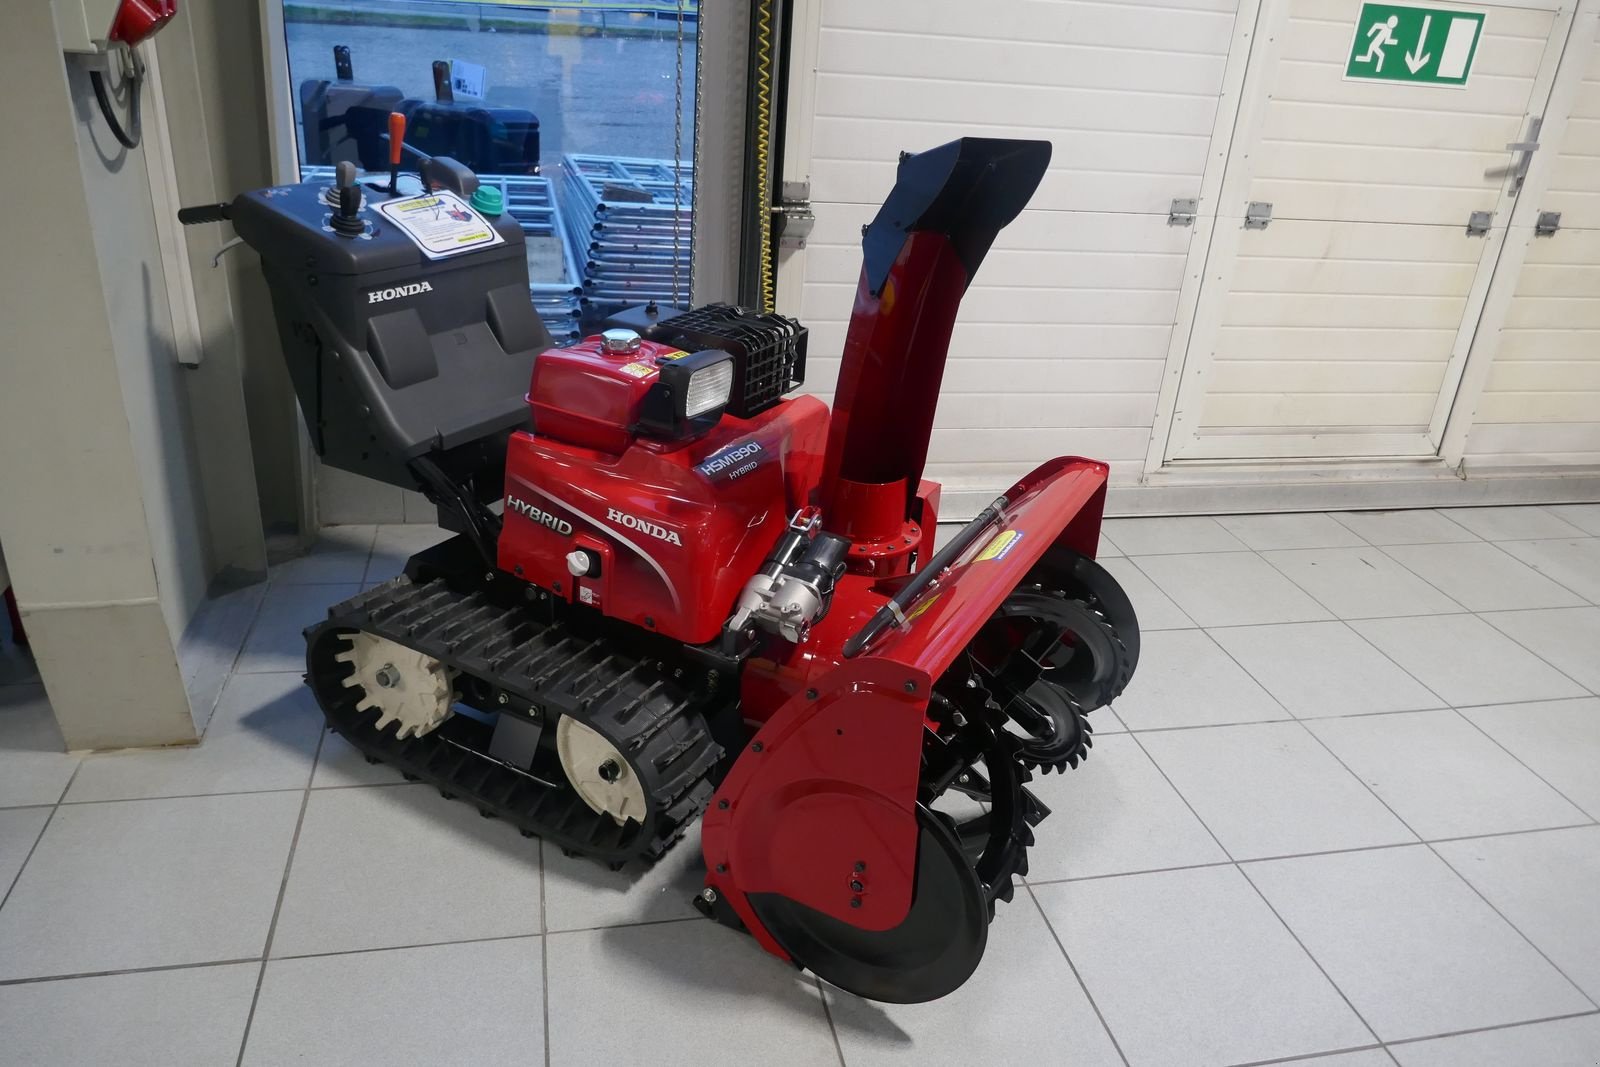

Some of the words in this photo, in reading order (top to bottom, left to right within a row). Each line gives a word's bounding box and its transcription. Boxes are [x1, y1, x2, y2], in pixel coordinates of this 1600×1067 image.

[368, 281, 433, 303] HONDA
[701, 442, 762, 476] HSM1390i
[728, 461, 758, 480] HYBRID
[506, 494, 573, 535] HYBRID
[606, 507, 683, 547] HONDA
